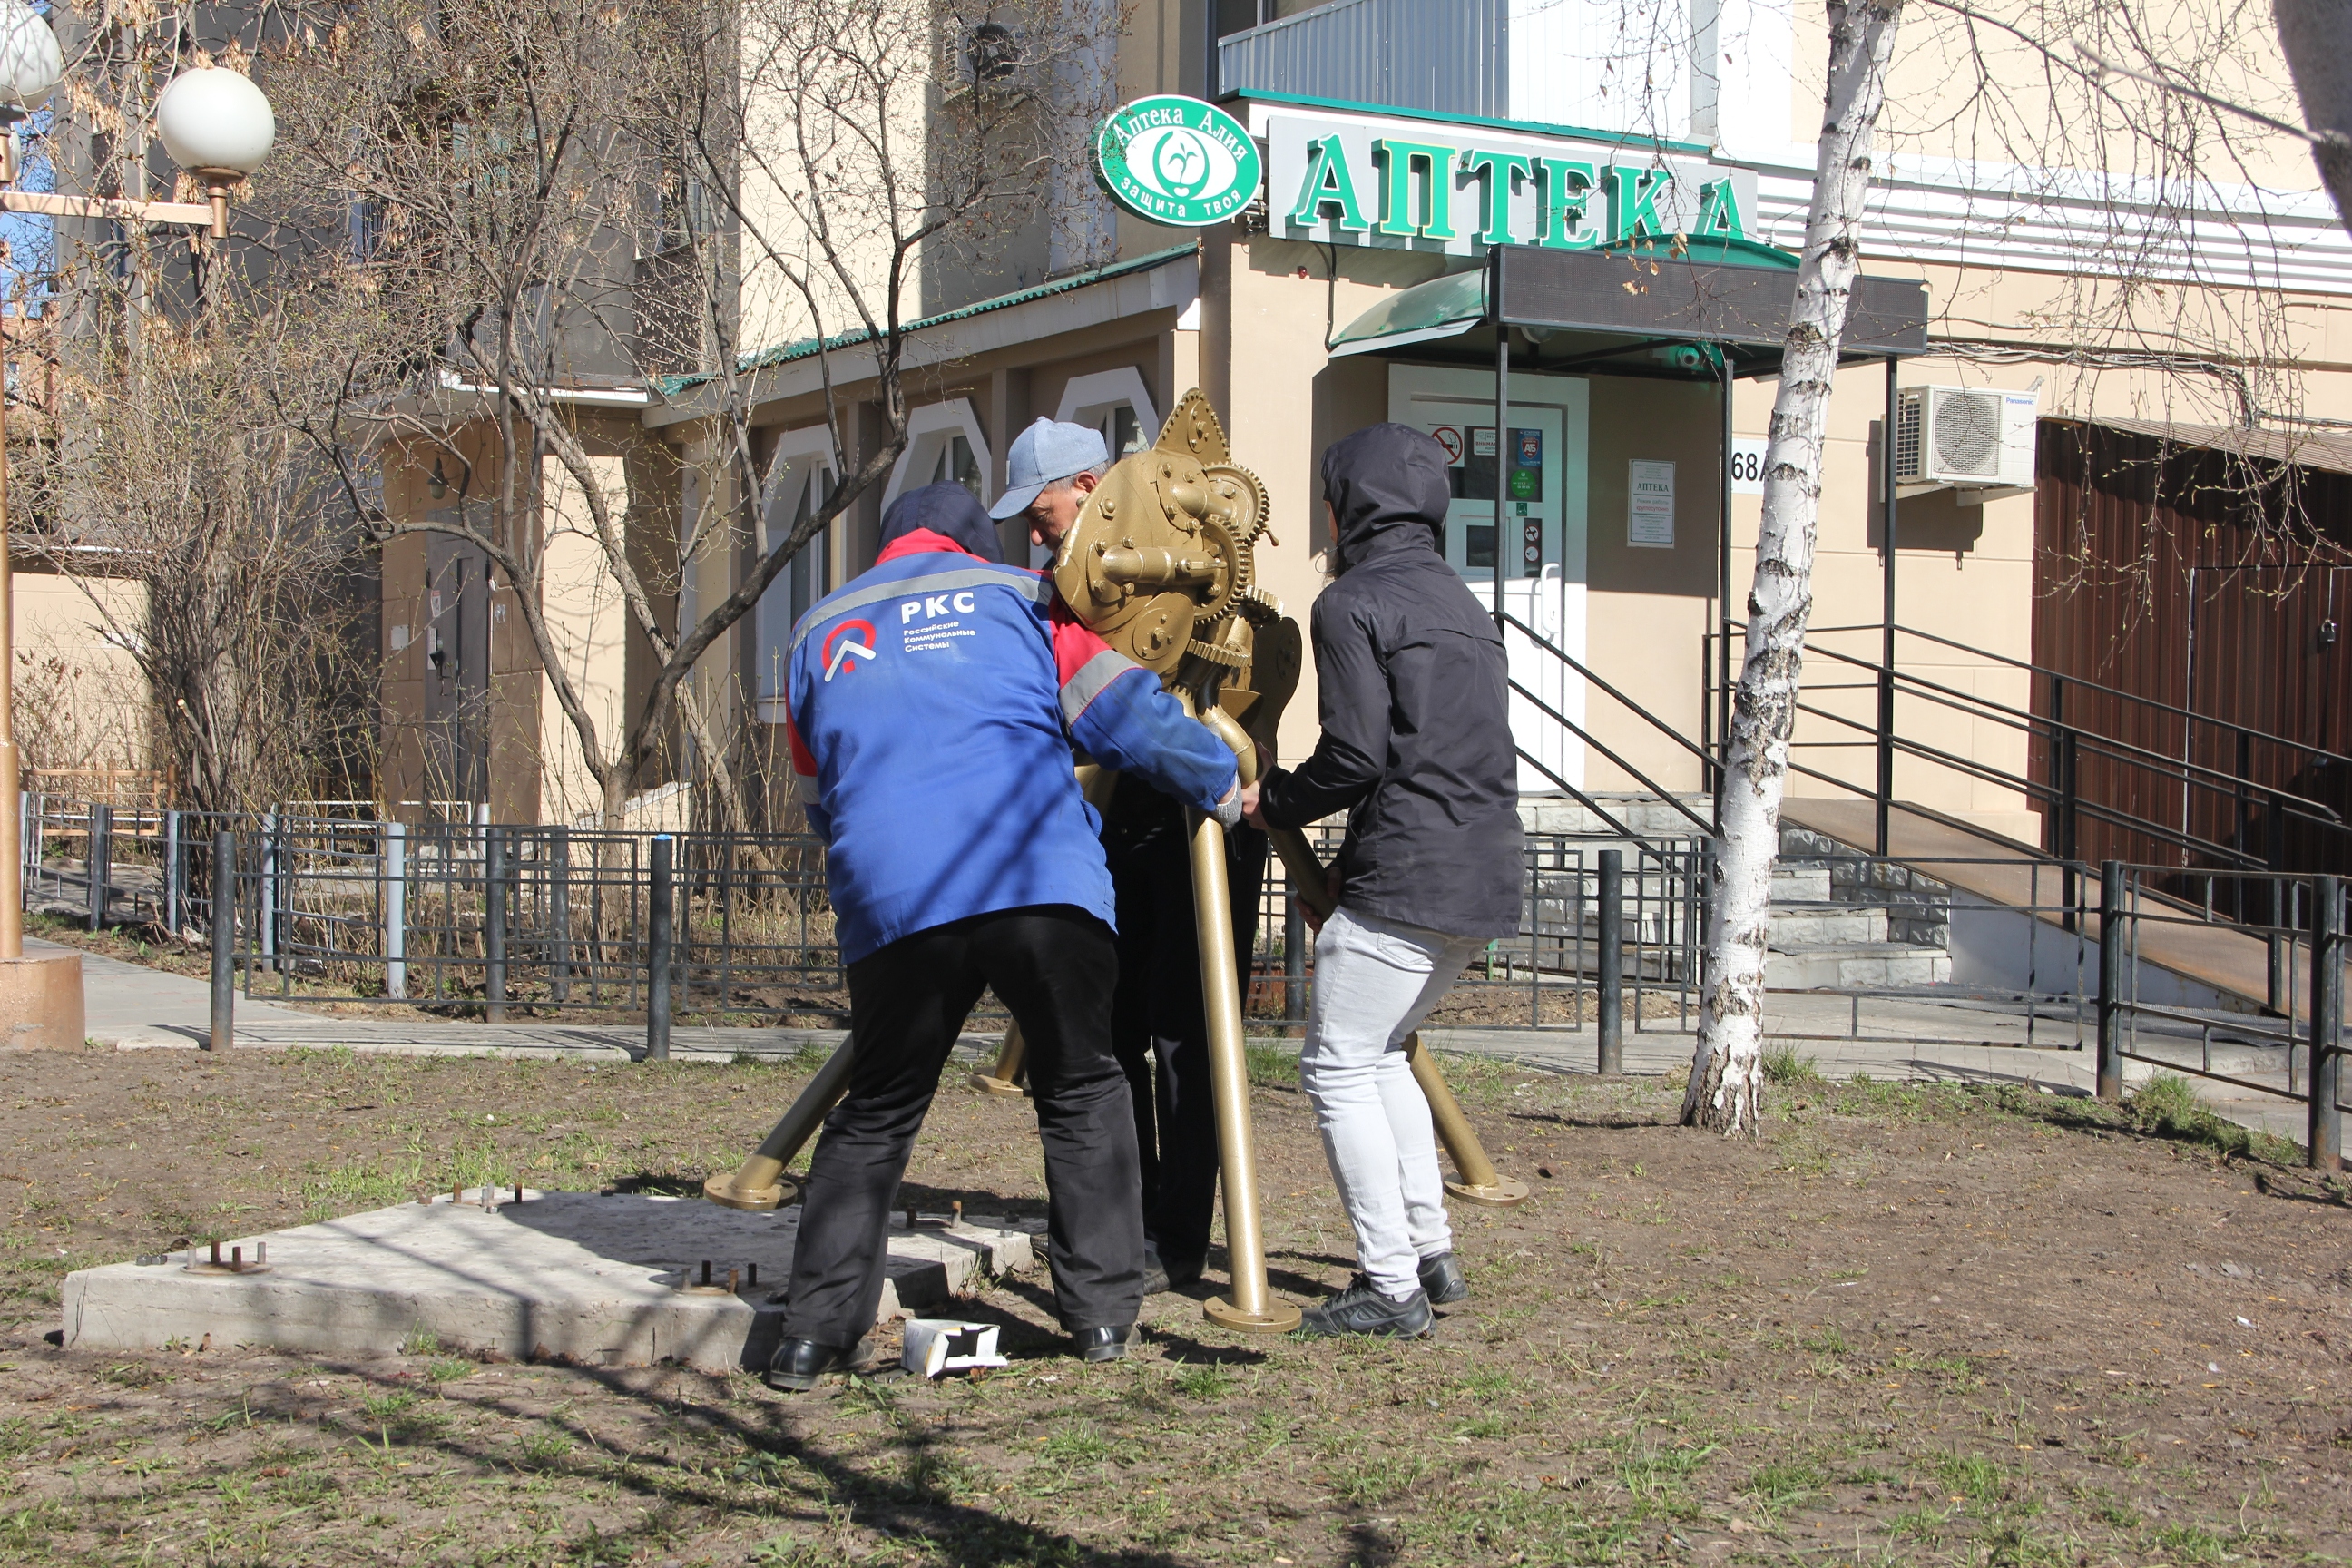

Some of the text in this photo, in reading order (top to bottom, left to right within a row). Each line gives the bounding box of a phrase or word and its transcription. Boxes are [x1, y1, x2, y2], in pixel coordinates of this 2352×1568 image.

[1113, 107, 1248, 162] Аптека Алия
[1120, 177, 1241, 217] защита твоя
[1289, 132, 1746, 250] АПТЕКА
[2006, 397, 2034, 405] Panasonic
[1637, 483, 1669, 492] АПТЕКА
[901, 592, 975, 624] РКС
[904, 621, 959, 636] Российские
[904, 630, 975, 643] Коммунальные
[905, 642, 950, 652] Системы
